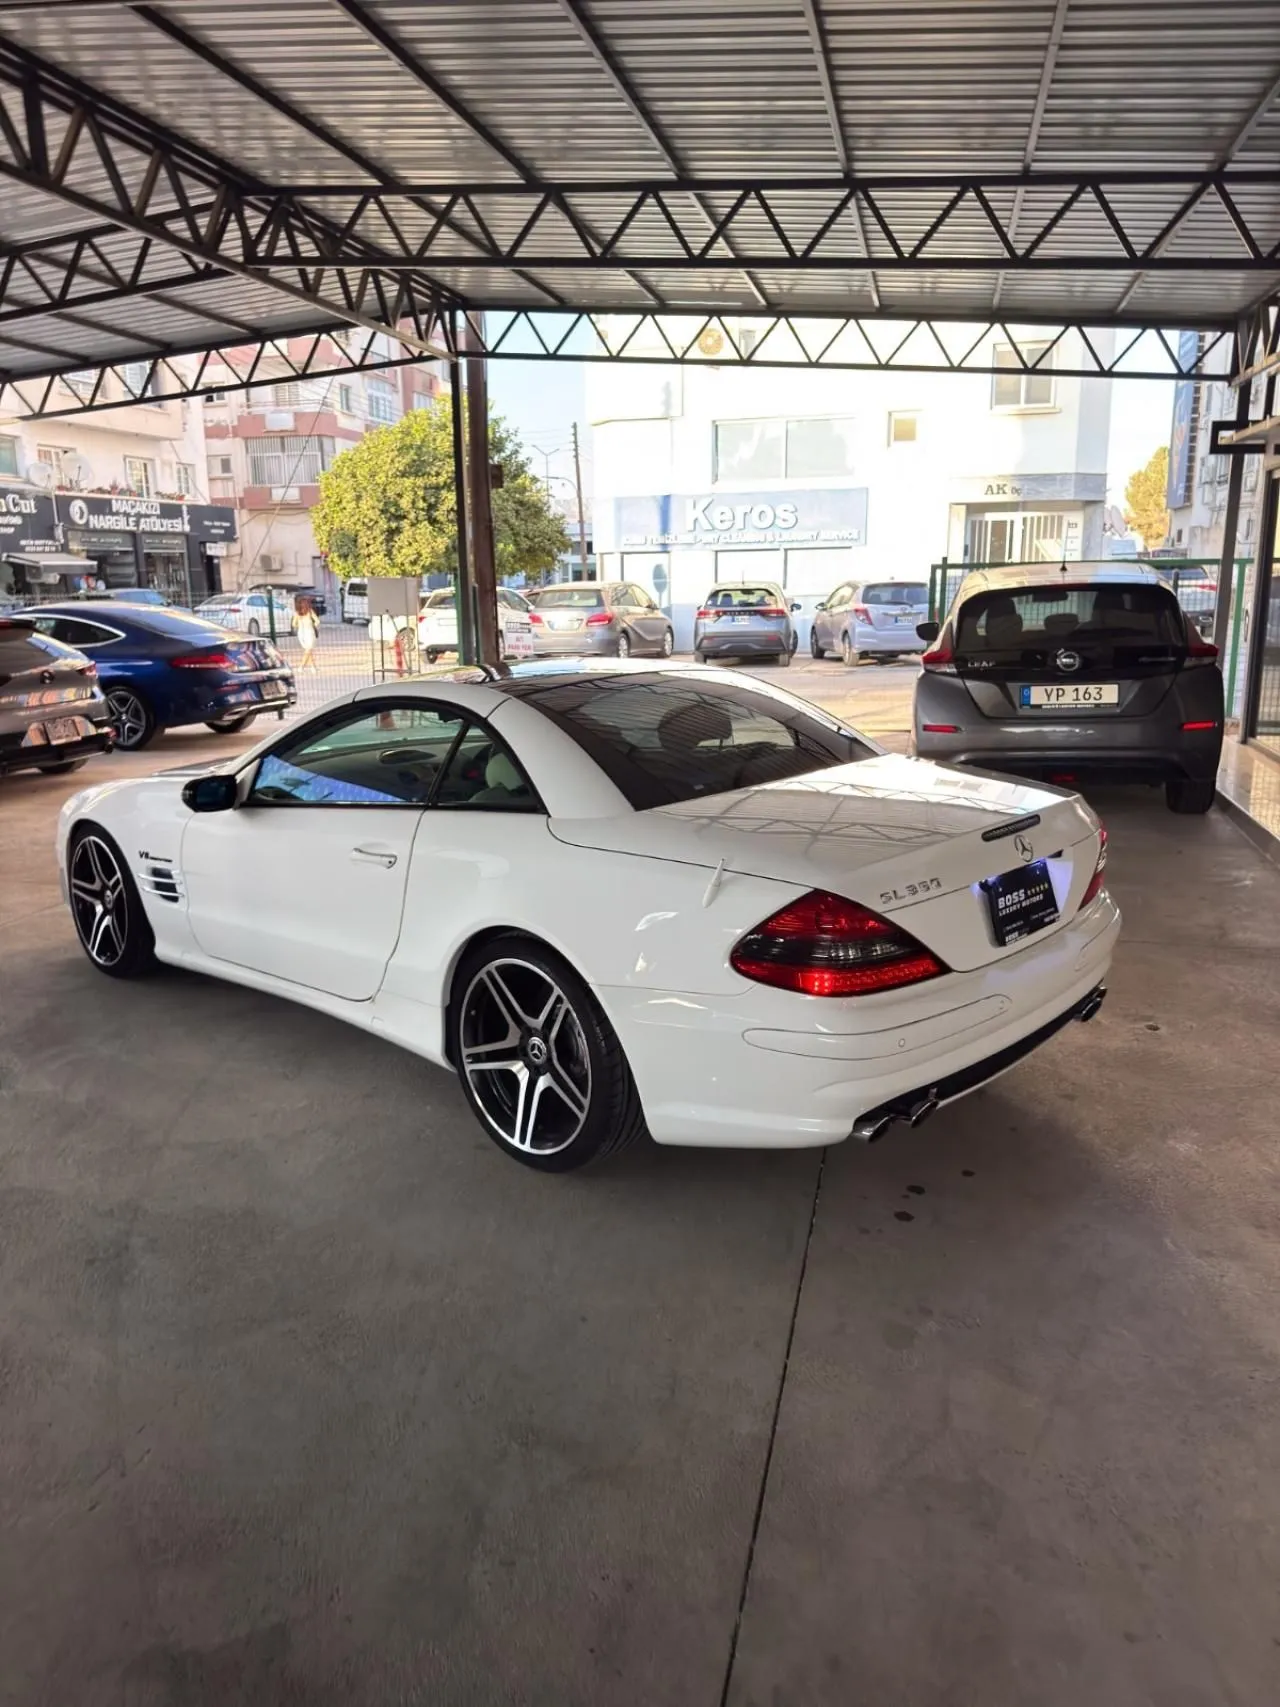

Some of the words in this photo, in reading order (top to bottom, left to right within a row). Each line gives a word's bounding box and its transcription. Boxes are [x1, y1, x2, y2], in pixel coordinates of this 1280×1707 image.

[984, 484, 1008, 495] AK
[89, 514, 137, 530] NARGİLE
[686, 497, 798, 532] Keros
[1044, 687, 1065, 702] YP
[1072, 686, 1103, 702] 163
[998, 888, 1025, 909] BOSS
